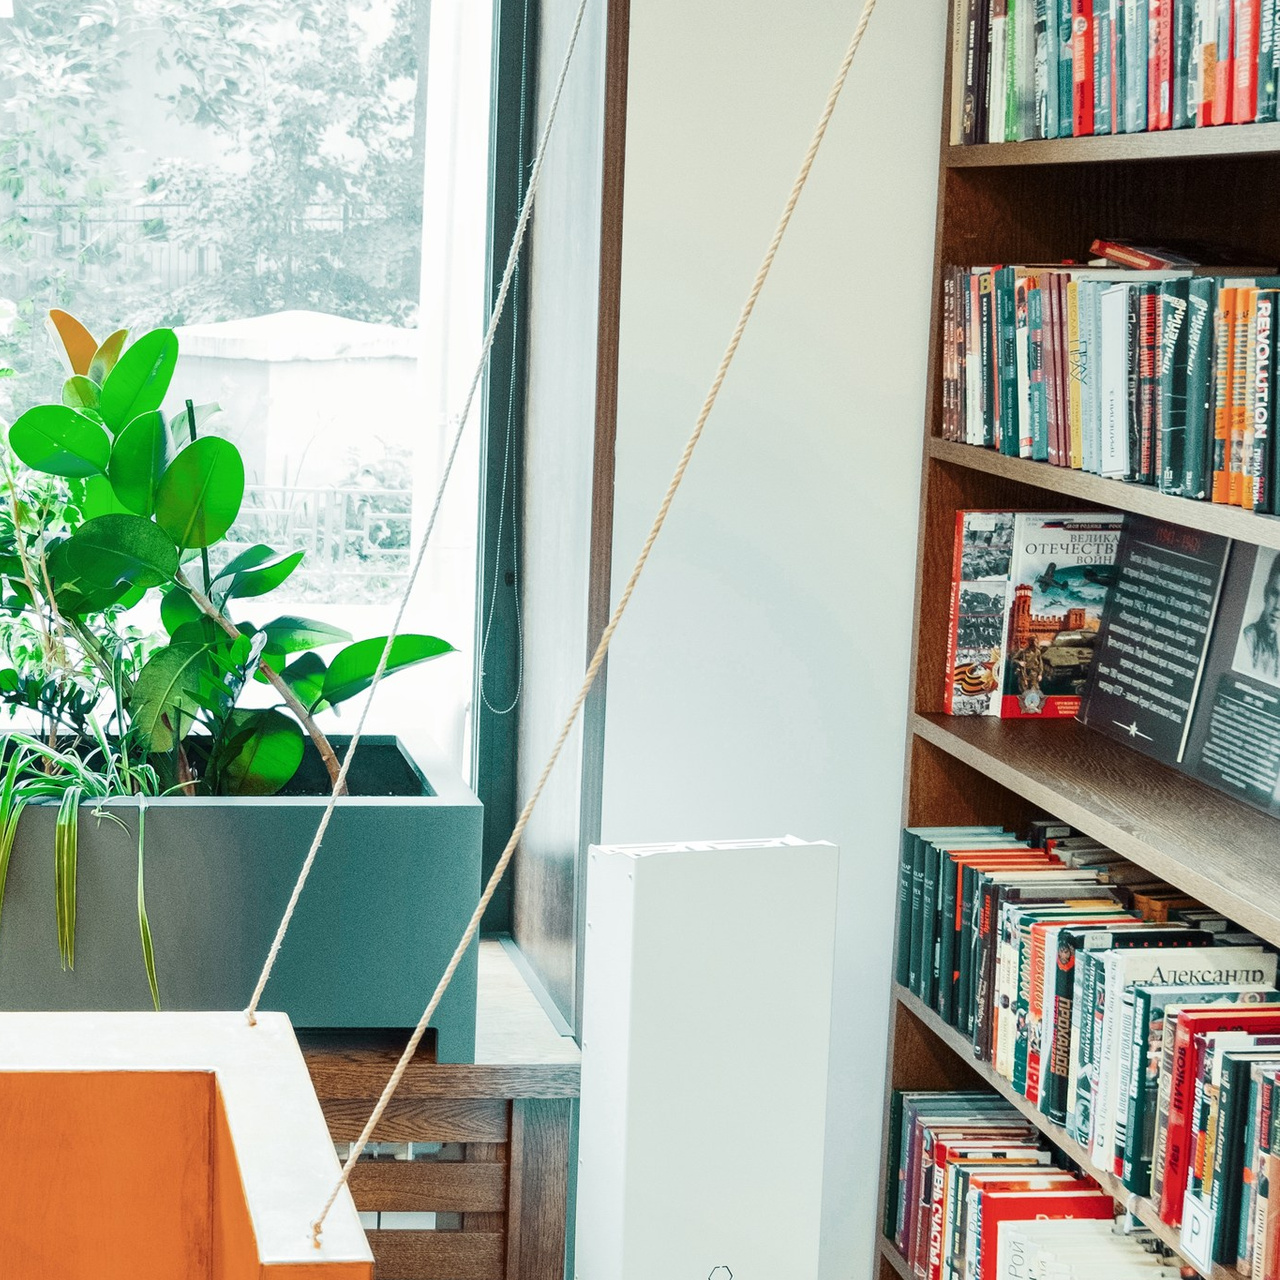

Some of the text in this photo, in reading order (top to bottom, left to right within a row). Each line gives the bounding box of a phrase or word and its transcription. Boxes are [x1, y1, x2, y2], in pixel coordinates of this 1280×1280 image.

[1254, 300, 1271, 439] REVOLUTION
[1026, 543, 1114, 554] ОТЕЧЕСТВ
[1070, 534, 1120, 543] ВЕЛИКА
[1077, 555, 1111, 564] ВОЙН
[946, 581, 957, 673] ВЕЛИКИХ ПОБЕД
[1056, 997, 1071, 1076] ПРОХАНОВ
[1173, 1046, 1187, 1111] ПУЧКОВ
[1170, 1144, 1180, 1176] ЛЕВ
[930, 1164, 944, 1267] ДЕНЬ СЧАСТЬЯ
